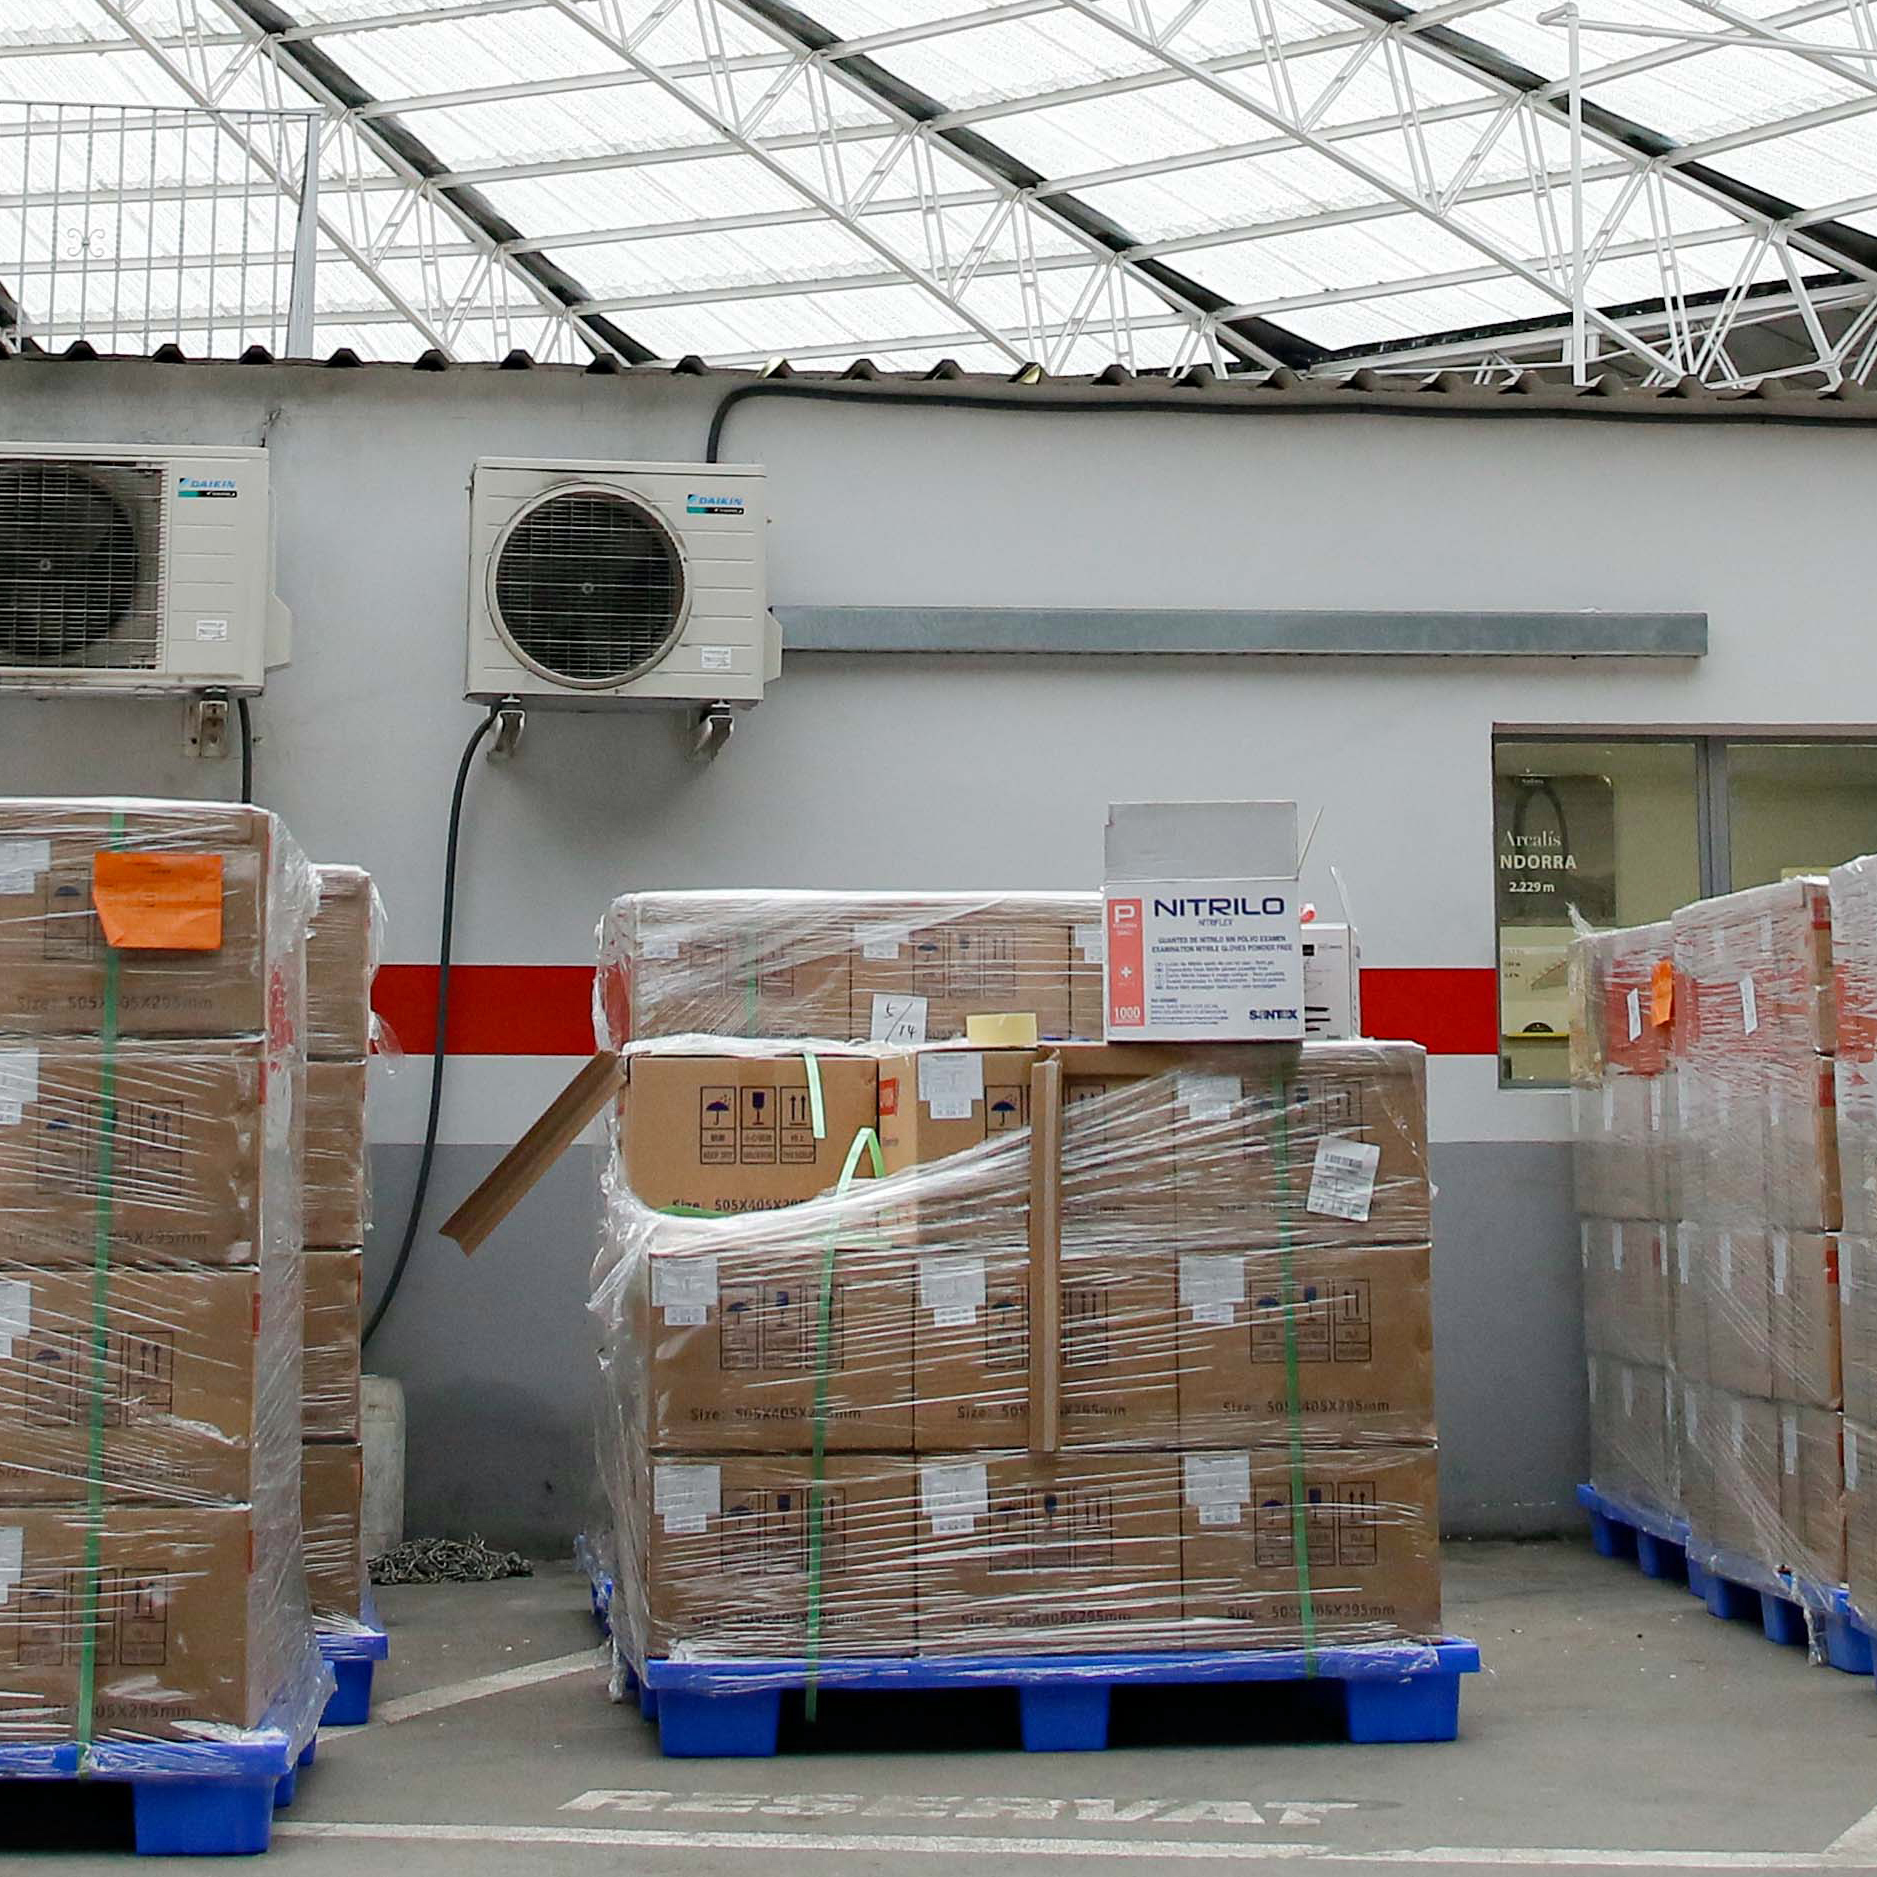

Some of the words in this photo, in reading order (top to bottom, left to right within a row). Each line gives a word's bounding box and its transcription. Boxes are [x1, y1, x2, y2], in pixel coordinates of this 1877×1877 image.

[1506, 830, 1562, 846] Arcalís
[1509, 881, 1541, 893] 2.229
[1543, 883, 1555, 893] m
[1115, 905, 1135, 924] P
[1154, 898, 1284, 916] NITRILO
[1115, 1006, 1140, 1021] 1000
[556, 1789, 1359, 1825] RESERVAT
